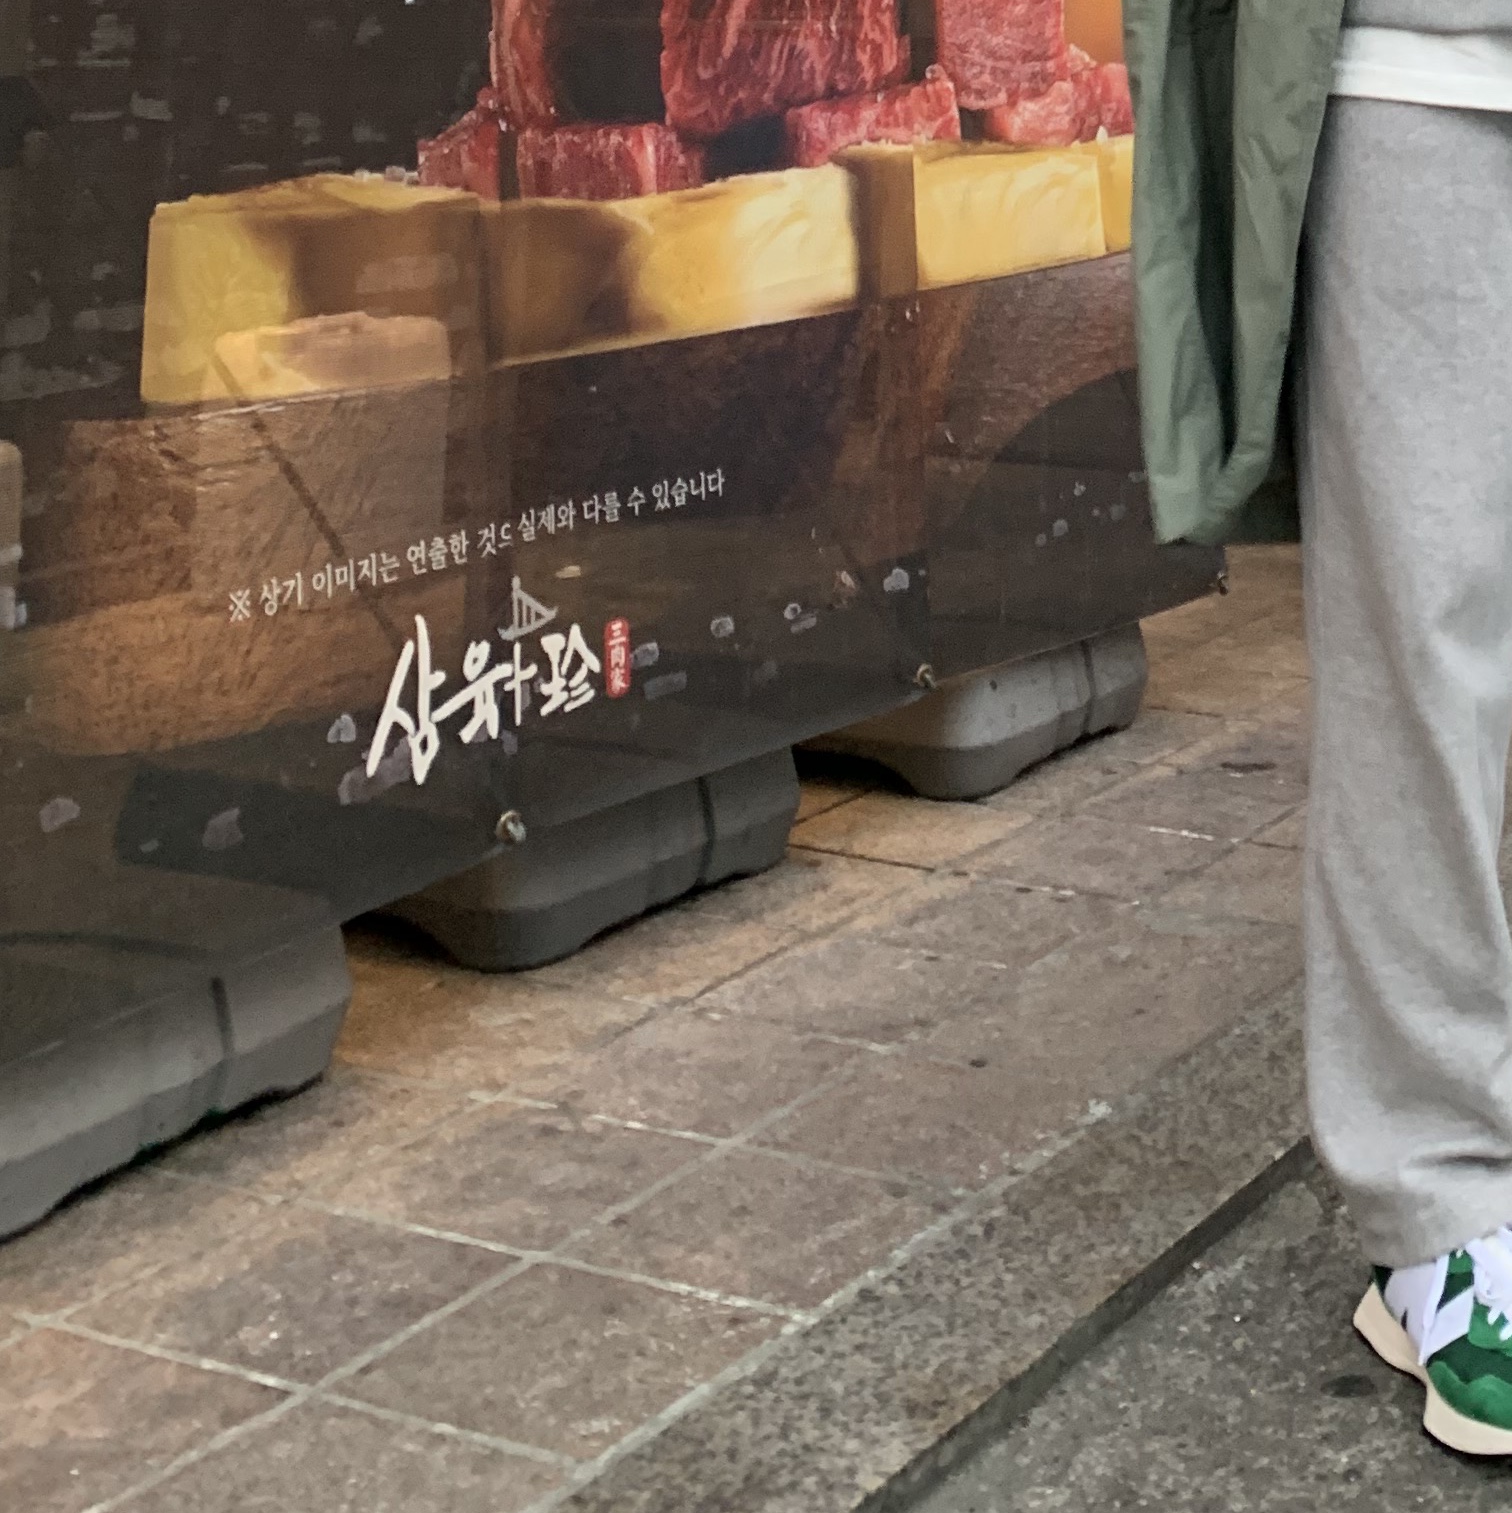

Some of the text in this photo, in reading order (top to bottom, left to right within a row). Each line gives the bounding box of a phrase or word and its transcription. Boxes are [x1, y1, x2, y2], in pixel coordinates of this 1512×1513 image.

[259, 572, 303, 616] 상기
[312, 553, 400, 599] 이미지는
[406, 529, 470, 575] 연출한
[517, 498, 577, 542] 실제와
[582, 491, 621, 524] 다를
[627, 486, 647, 517] 수
[651, 467, 726, 512] 있습니다
